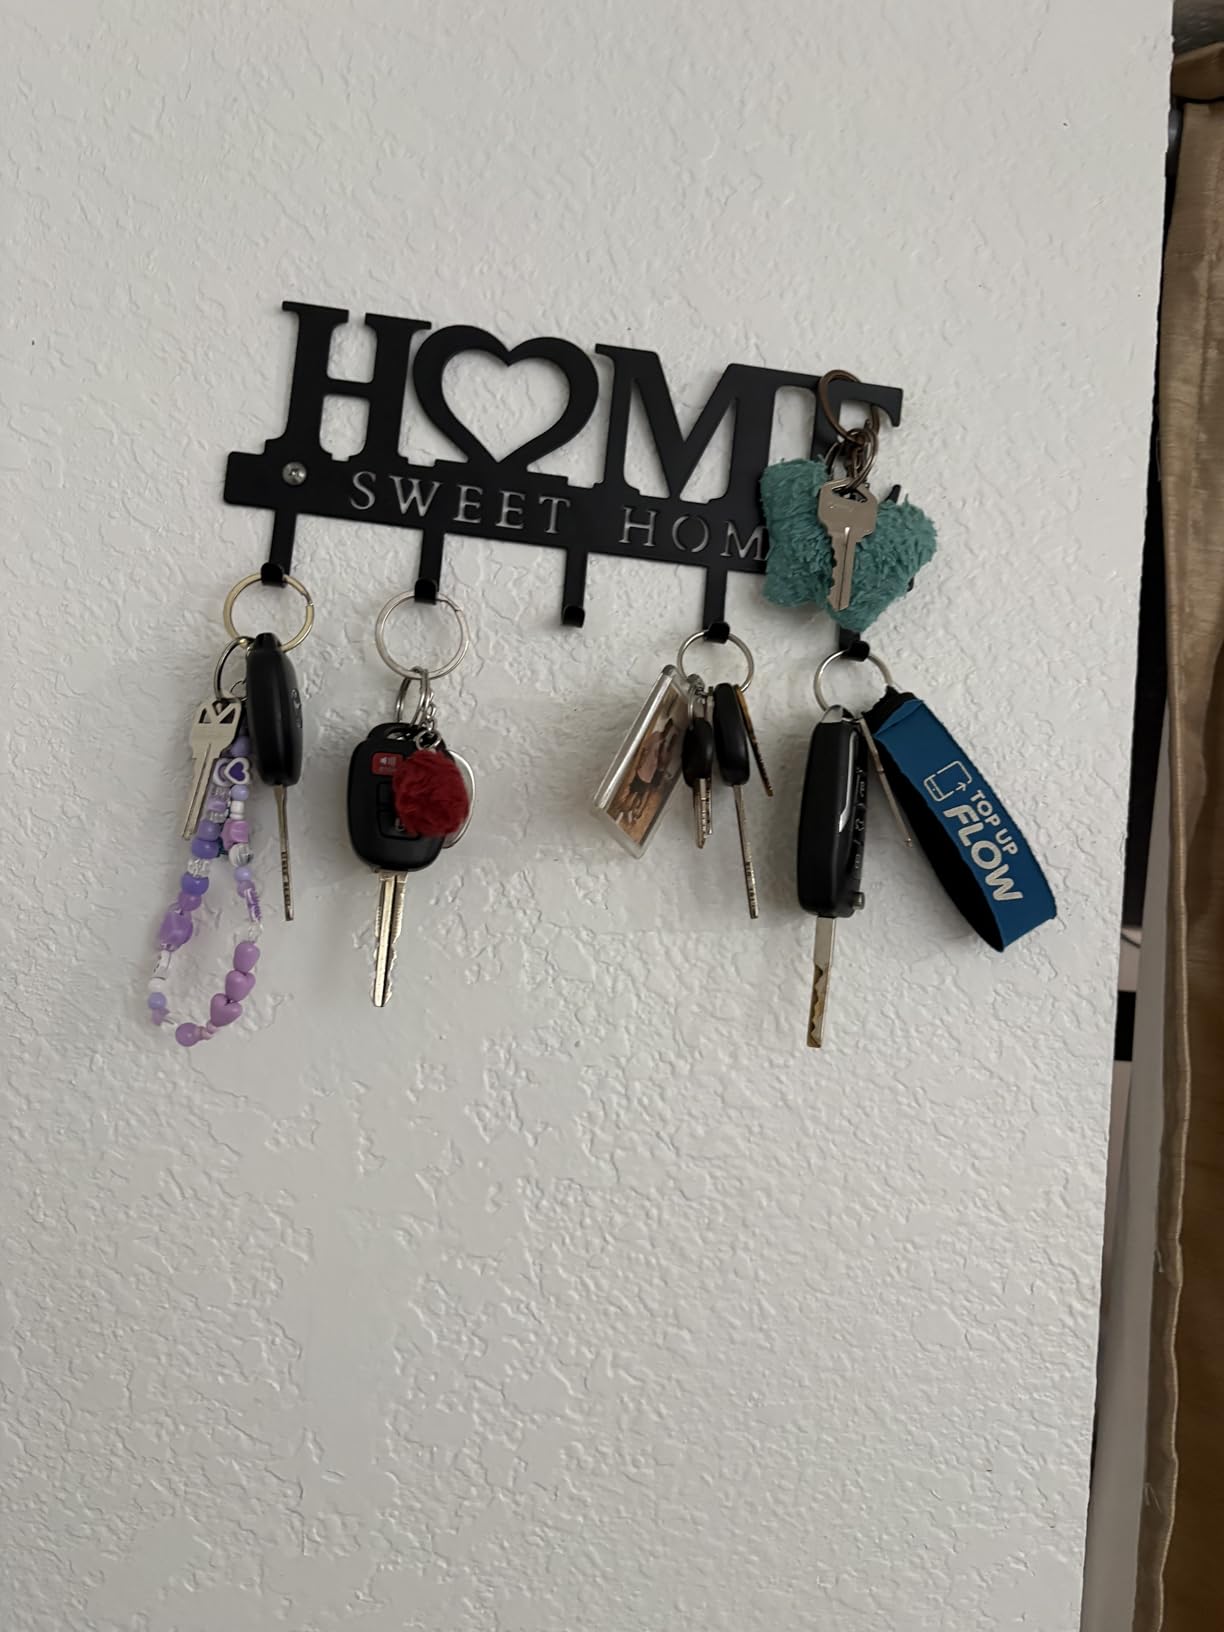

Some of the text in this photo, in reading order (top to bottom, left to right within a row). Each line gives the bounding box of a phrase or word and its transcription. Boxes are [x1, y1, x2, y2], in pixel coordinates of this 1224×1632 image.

[348, 470, 769, 562] SWEET HOM
[943, 803, 1024, 902] FLOW
[969, 789, 1019, 856] TOP UP
